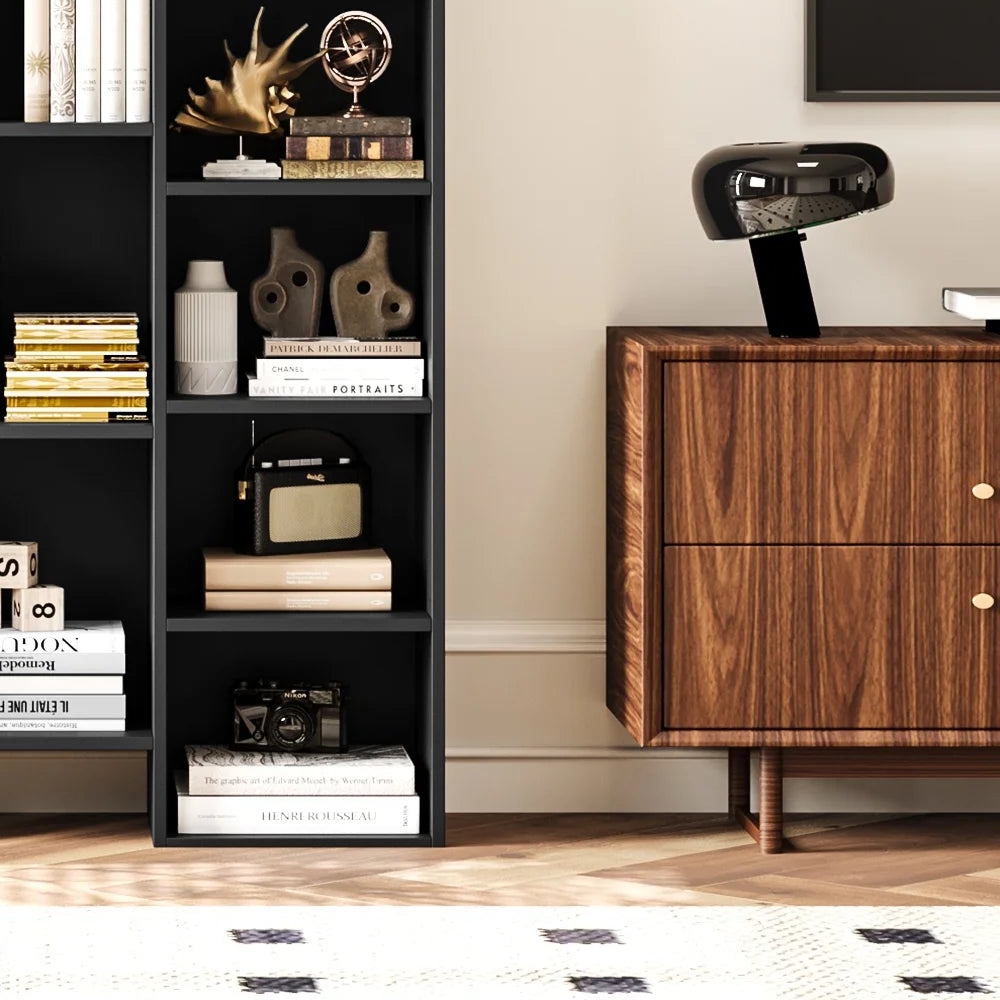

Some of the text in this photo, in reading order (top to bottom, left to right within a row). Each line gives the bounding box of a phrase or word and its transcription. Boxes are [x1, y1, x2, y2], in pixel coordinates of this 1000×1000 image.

[270, 345, 403, 353] PATRICK DEMARCHELIER
[253, 384, 404, 394] VANITY FAIR PORTRAITS
[32, 602, 56, 618] 8
[7, 701, 28, 713] UNE
[30, 701, 58, 715] ÉTAIT
[59, 701, 69, 713] IL
[204, 777, 218, 785] The
[220, 777, 247, 787] graphic
[249, 777, 261, 785] art
[262, 812, 377, 821] HENRI ROUSSEAU
